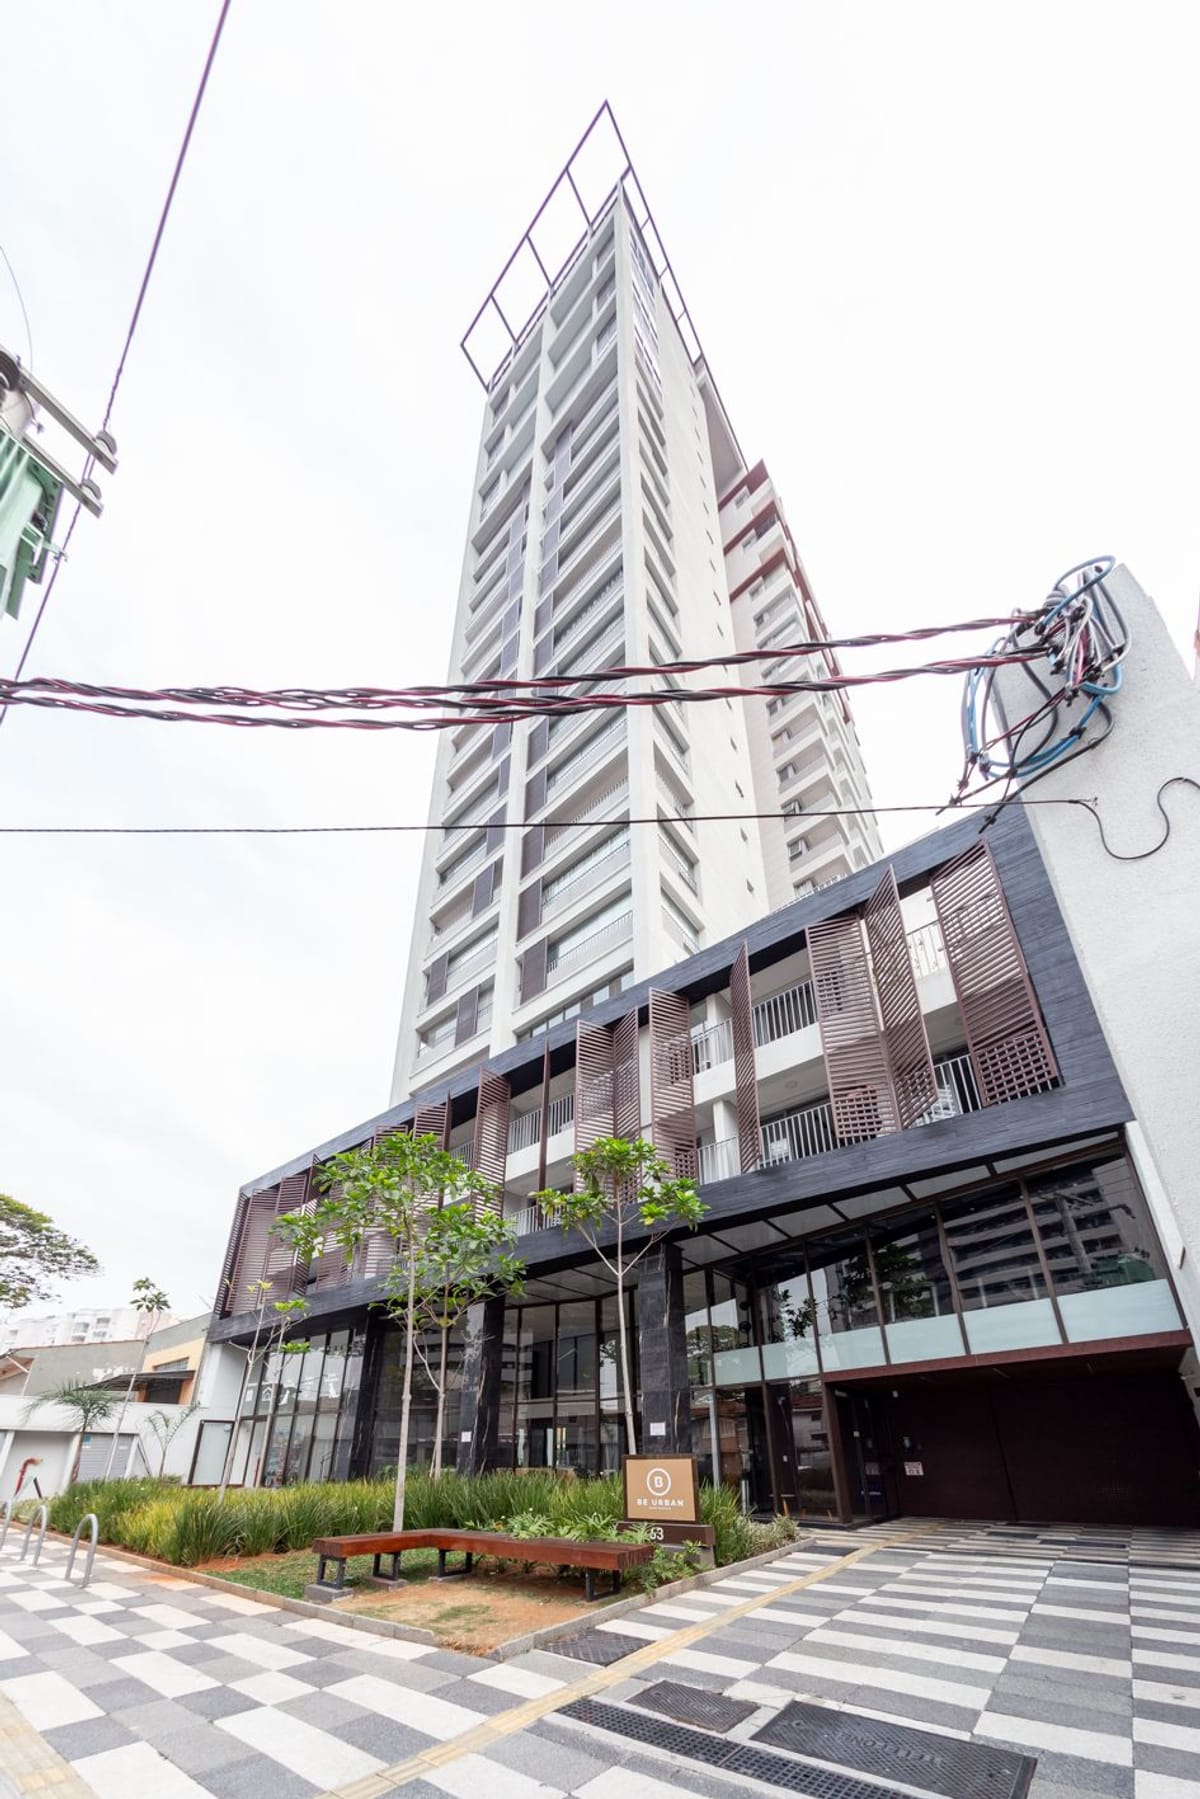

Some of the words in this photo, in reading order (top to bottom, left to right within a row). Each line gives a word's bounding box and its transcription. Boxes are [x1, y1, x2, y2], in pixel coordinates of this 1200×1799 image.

[655, 1476, 663, 1487] B
[637, 1498, 648, 1506] BE
[651, 1498, 684, 1507] URBAN
